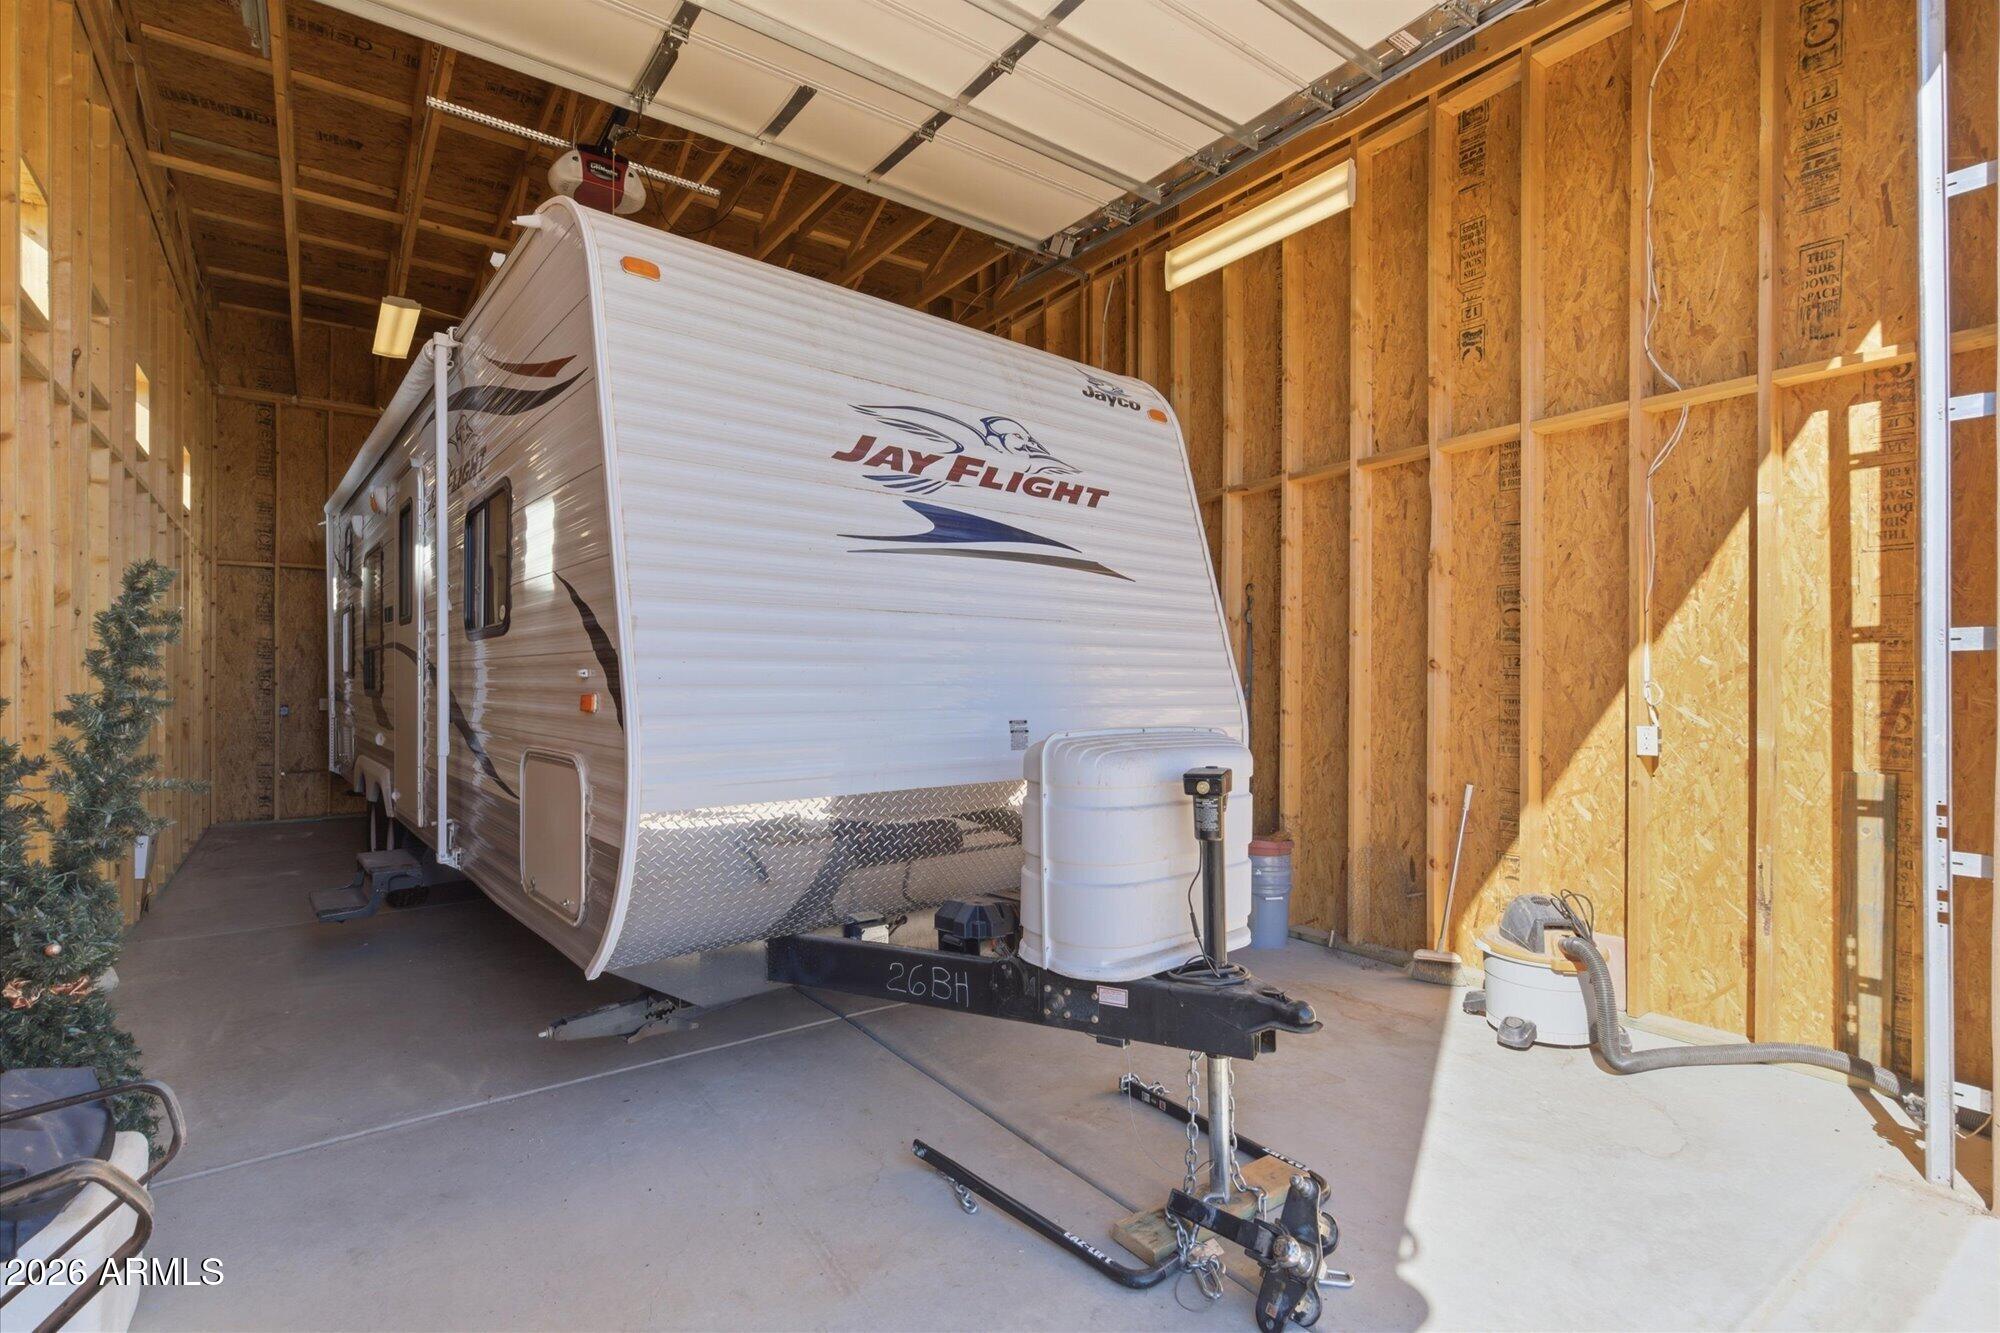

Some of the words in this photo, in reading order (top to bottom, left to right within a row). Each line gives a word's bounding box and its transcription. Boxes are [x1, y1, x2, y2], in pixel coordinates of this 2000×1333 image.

[1804, 111, 1838, 131] JAN
[1807, 248, 1837, 263] THIS
[1806, 261, 1835, 277] SIDE
[1082, 385, 1141, 411] Jayco
[831, 435, 944, 475] JAY
[946, 455, 1110, 508] FLIGHT
[886, 962, 970, 1007] 26BH
